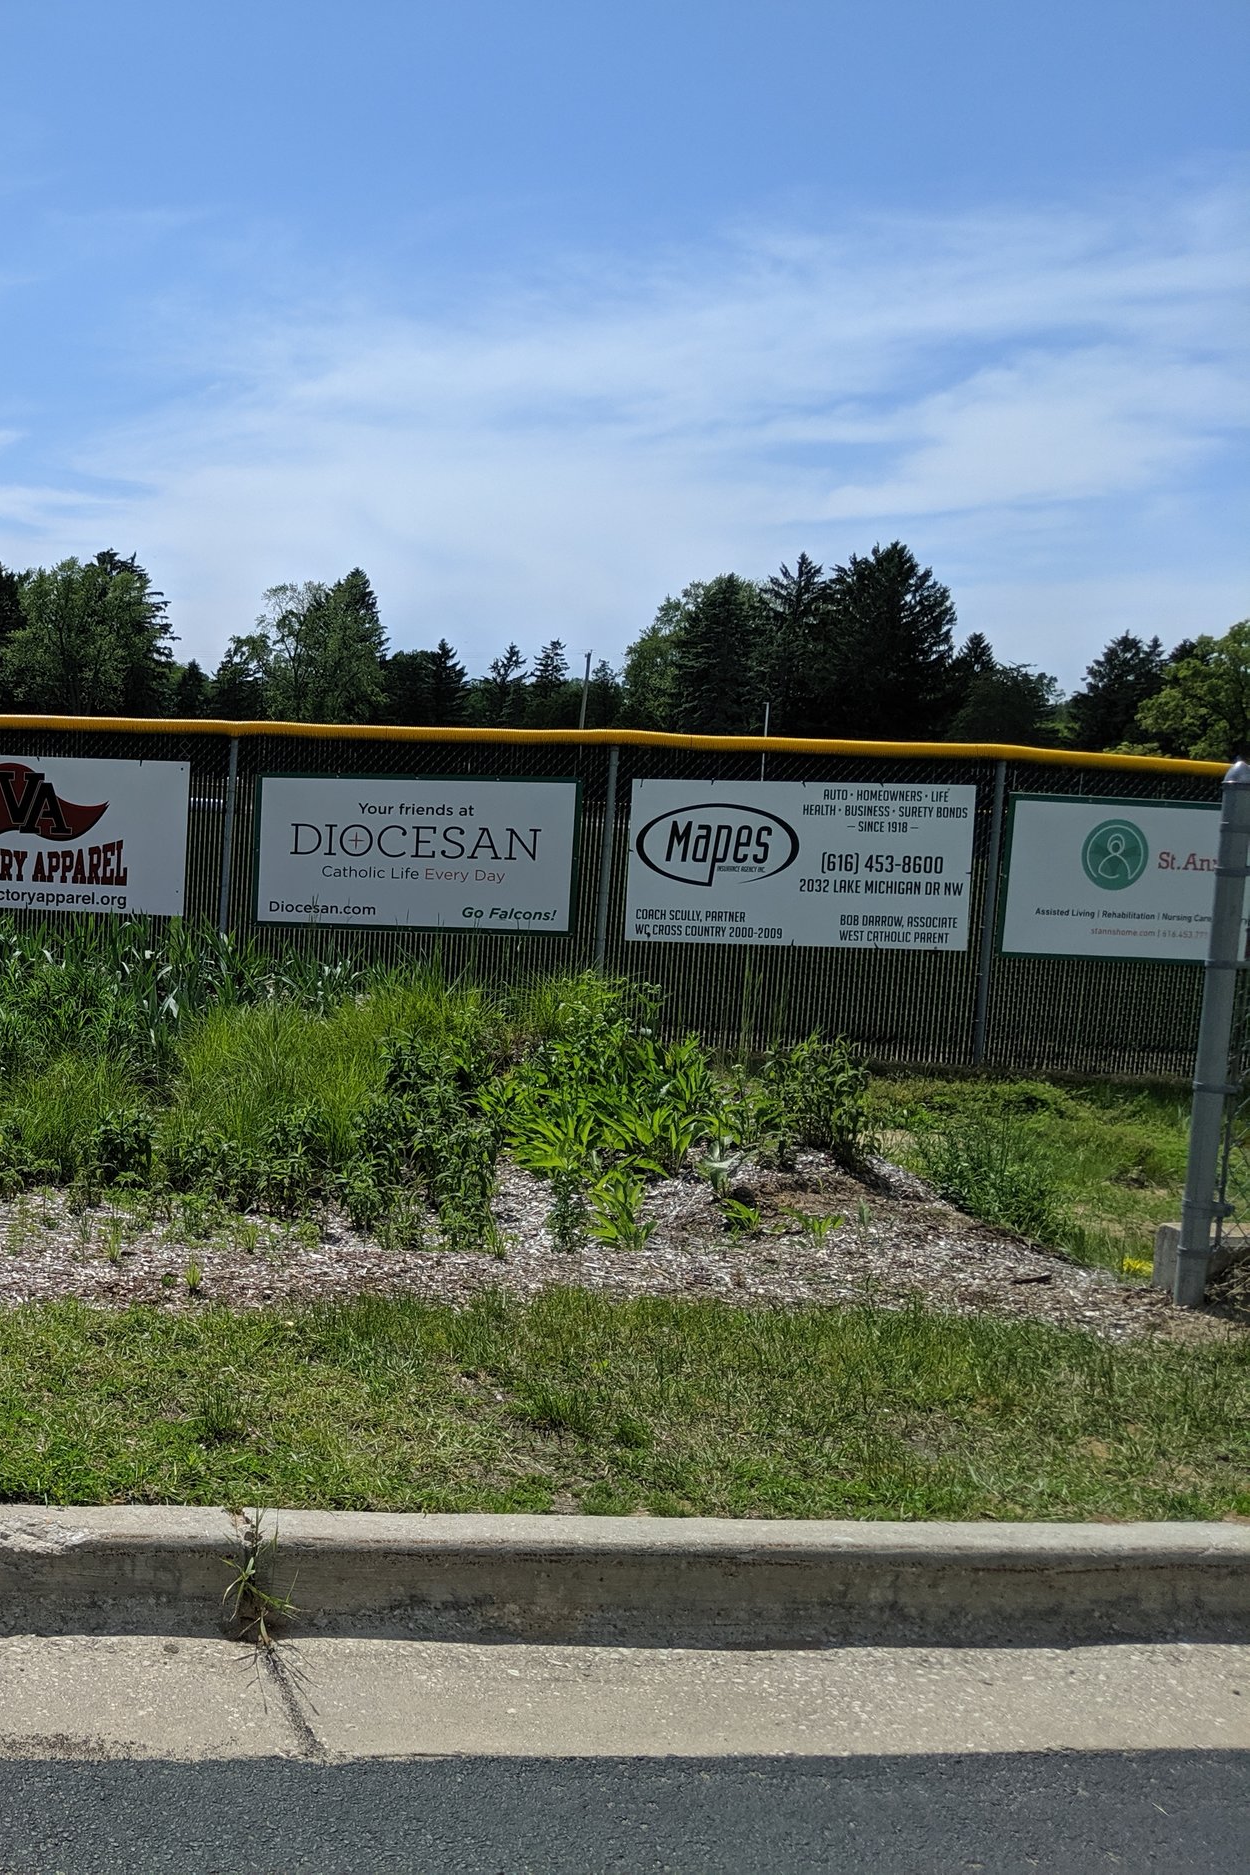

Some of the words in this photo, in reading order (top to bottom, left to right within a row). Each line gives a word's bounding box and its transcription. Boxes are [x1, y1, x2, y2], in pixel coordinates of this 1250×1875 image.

[823, 788, 849, 801] AUTO
[856, 789, 923, 802] HOMEOWNERS
[931, 790, 949, 803] LIFE
[358, 802, 394, 816] Your
[399, 803, 454, 817] friends
[458, 804, 475, 817] at
[802, 803, 837, 816] HEALTH
[844, 804, 891, 817] BUSINESS
[898, 806, 934, 818] SURETY
[936, 806, 968, 819] BONDS
[858, 821, 885, 833] SINCE
[887, 821, 908, 834] 1918
[290, 823, 542, 862] DIOCESAN
[665, 820, 773, 886] Mapes
[31, 839, 128, 887] APPAREL
[821, 851, 859, 875] (616)
[864, 854, 944, 875] 453-8600
[321, 865, 385, 880] Catholic
[390, 866, 419, 881] Life
[425, 868, 469, 884] Every
[474, 869, 506, 884] Day
[799, 878, 829, 894] 2032
[833, 879, 861, 894] LAKE
[864, 880, 922, 896] MICHIGAN
[925, 882, 941, 896] DR
[944, 882, 963, 897] NW
[269, 900, 377, 916] Diocesan.com
[461, 906, 484, 920] Go
[489, 907, 557, 922] Falcons!
[635, 908, 666, 921] COACH
[669, 909, 703, 923] SCULLY,
[705, 910, 746, 923] PARTNER
[1035, 907, 1070, 917] Assisted
[1071, 908, 1095, 919] Living
[1102, 910, 1155, 921] Rehabilitation
[1161, 912, 1193, 923] Nursing
[840, 914, 859, 927] BOB
[861, 915, 904, 929] DARROW,
[907, 916, 958, 929] ASSOCIATE
[652, 924, 683, 936] CROSS
[684, 925, 727, 938] COUNTRY
[729, 926, 783, 939] 2000-2009
[839, 929, 864, 942] WEST
[866, 930, 911, 943] CATHOLIC
[913, 931, 950, 944] PARENT
[1091, 927, 1156, 937] stannshome.com
